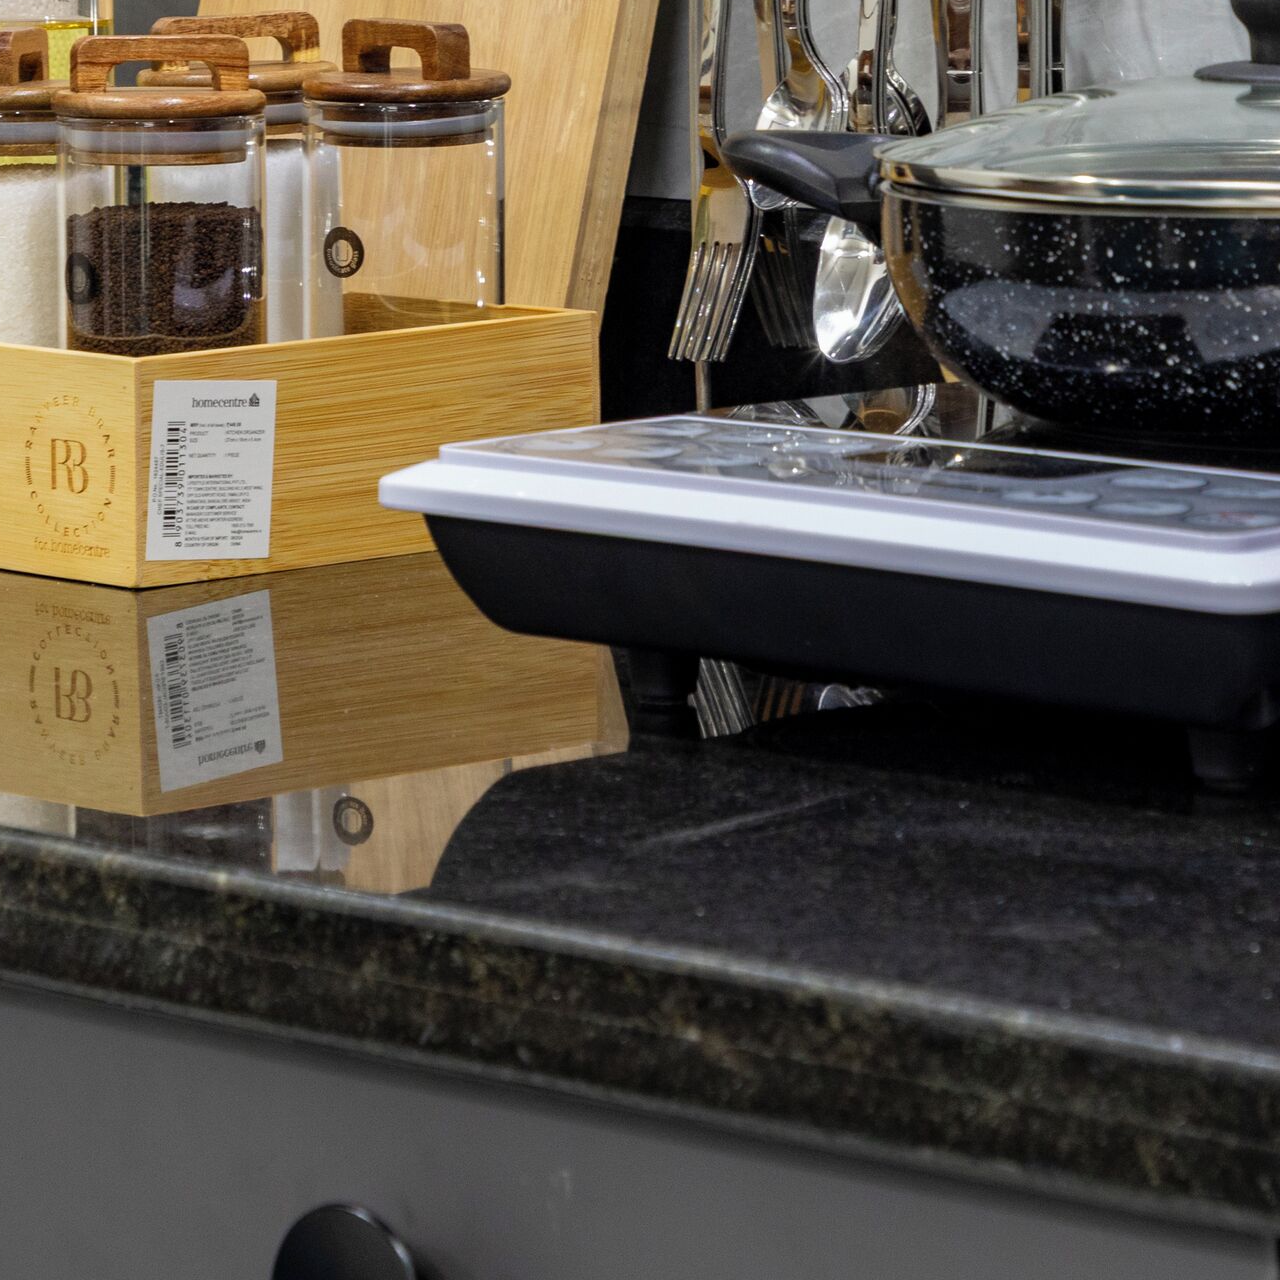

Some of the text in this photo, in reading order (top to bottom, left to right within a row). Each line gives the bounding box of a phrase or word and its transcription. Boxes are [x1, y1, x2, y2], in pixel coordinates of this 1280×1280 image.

[192, 397, 248, 409] homecentre
[178, 427, 187, 477] 011304
[176, 483, 185, 532] 903739
[50, 538, 111, 559] homecentre
